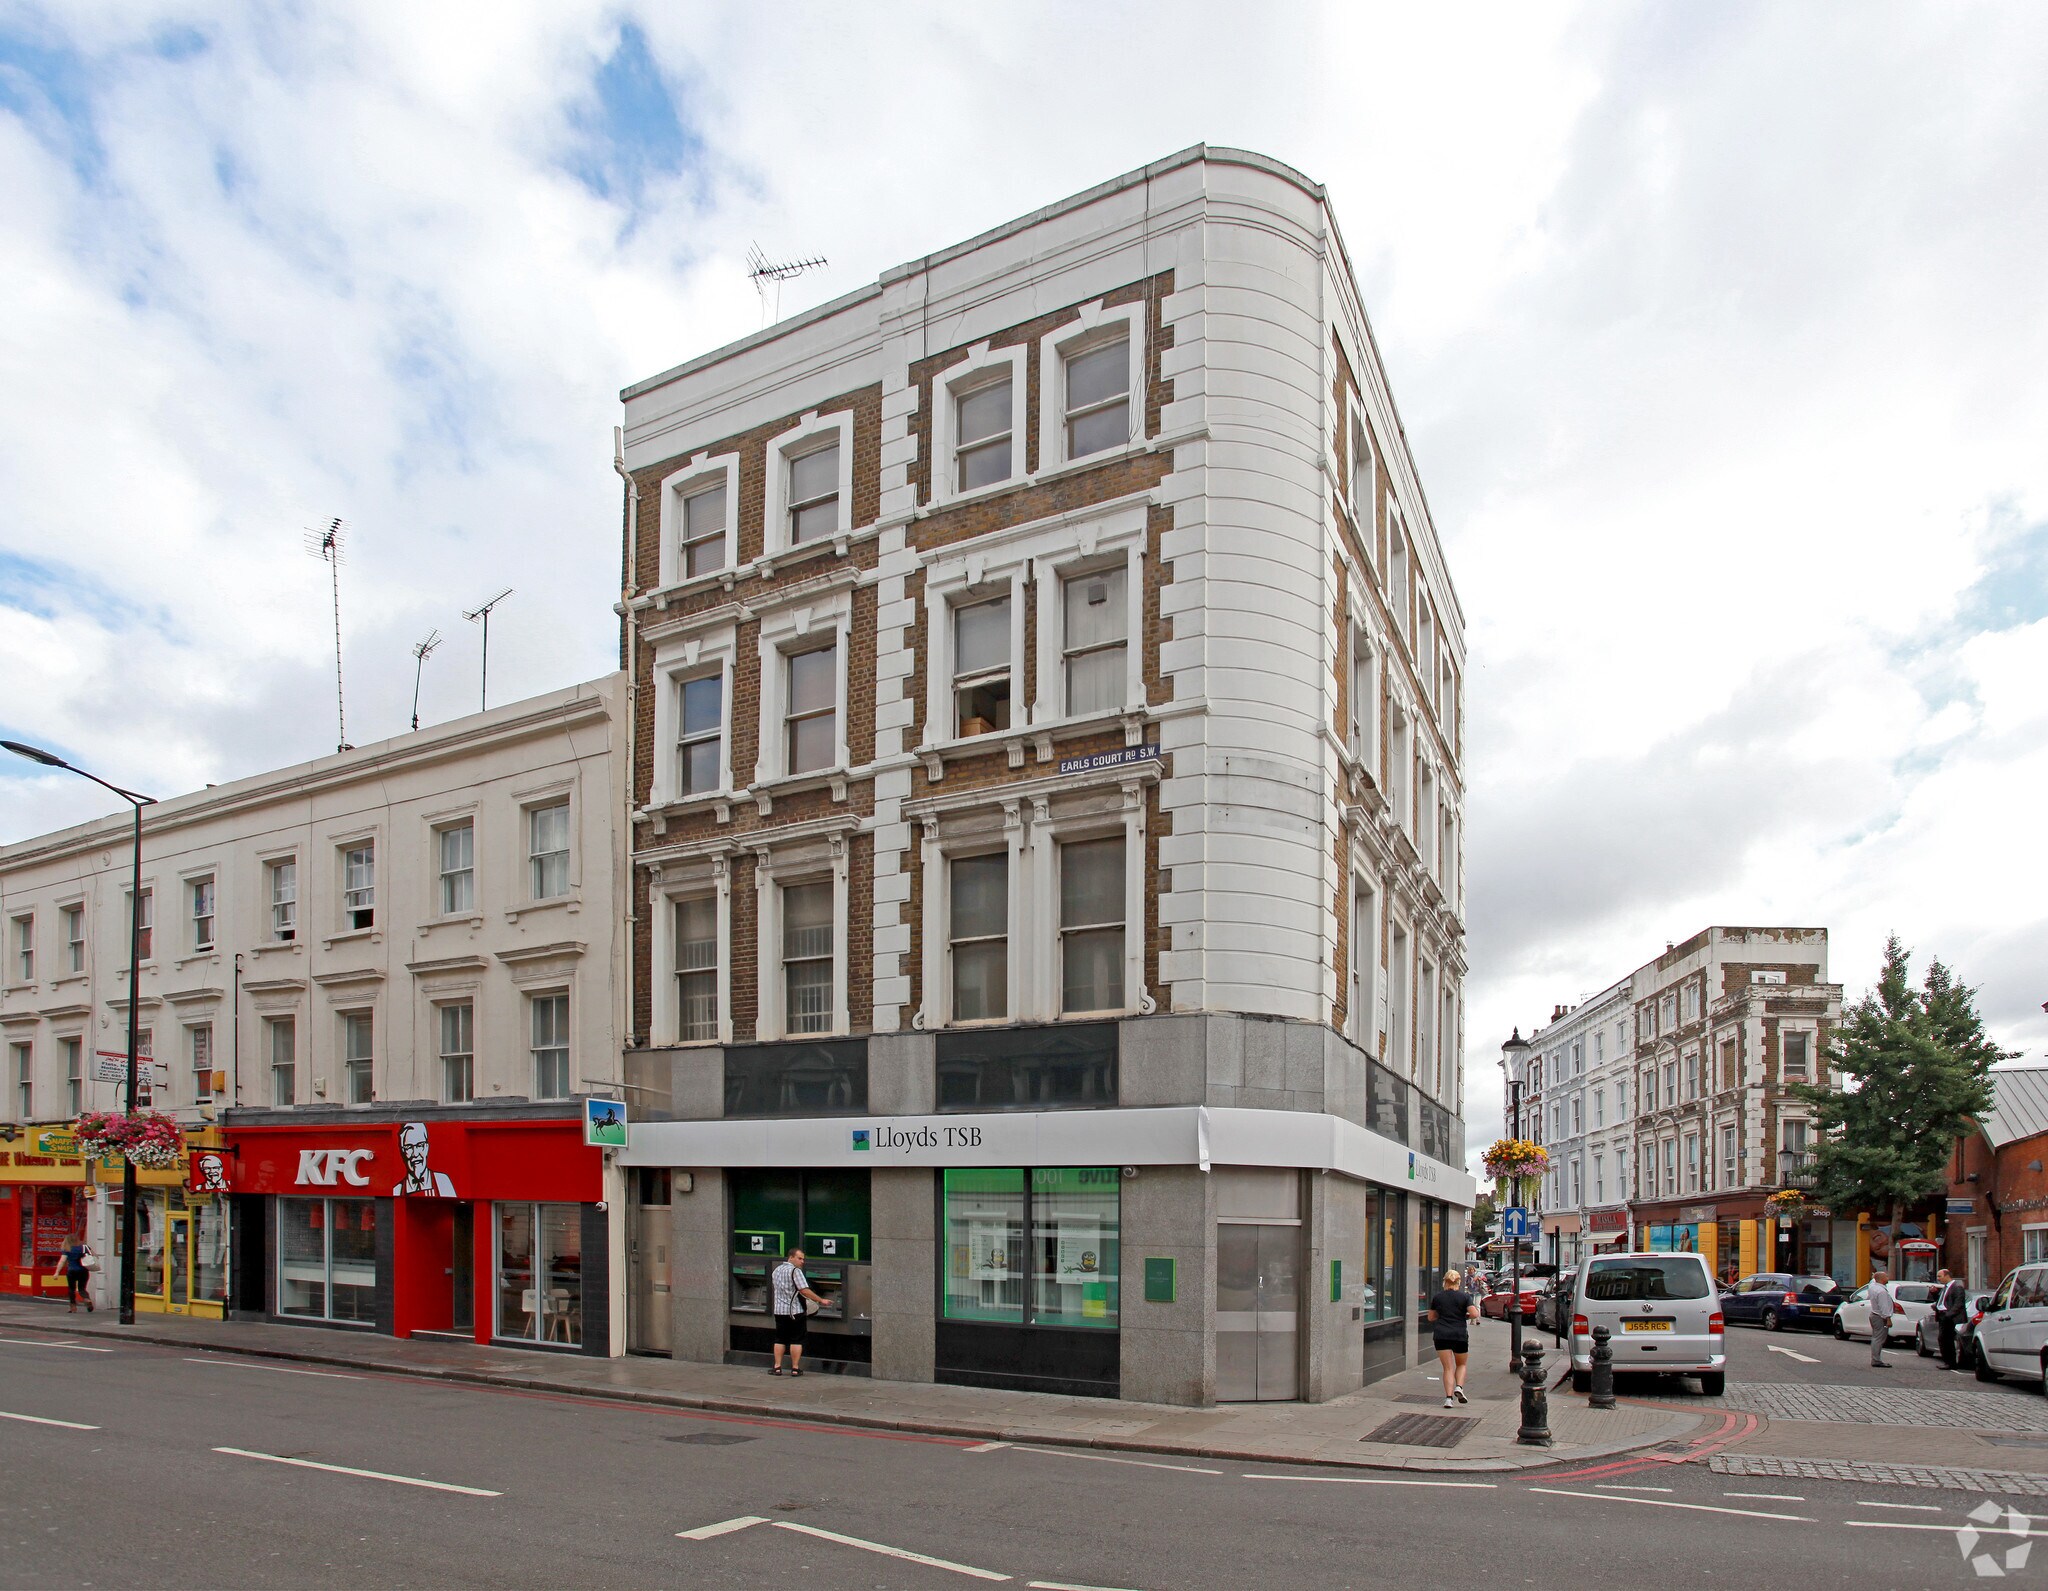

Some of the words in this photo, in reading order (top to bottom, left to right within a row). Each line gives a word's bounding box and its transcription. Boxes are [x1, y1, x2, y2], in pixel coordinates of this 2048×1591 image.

[1061, 759, 1090, 773] EARLS
[1093, 753, 1123, 767] COURT
[1140, 747, 1157, 758] S.W.
[45, 1135, 75, 1147] SNAPP
[50, 1144, 75, 1153] SNAPS
[876, 1126, 938, 1154] Lloyds
[944, 1127, 982, 1147] TSB
[294, 1149, 374, 1186] KFC
[1416, 1159, 1429, 1184] Lloyds
[1813, 1209, 1831, 1218] Shop
